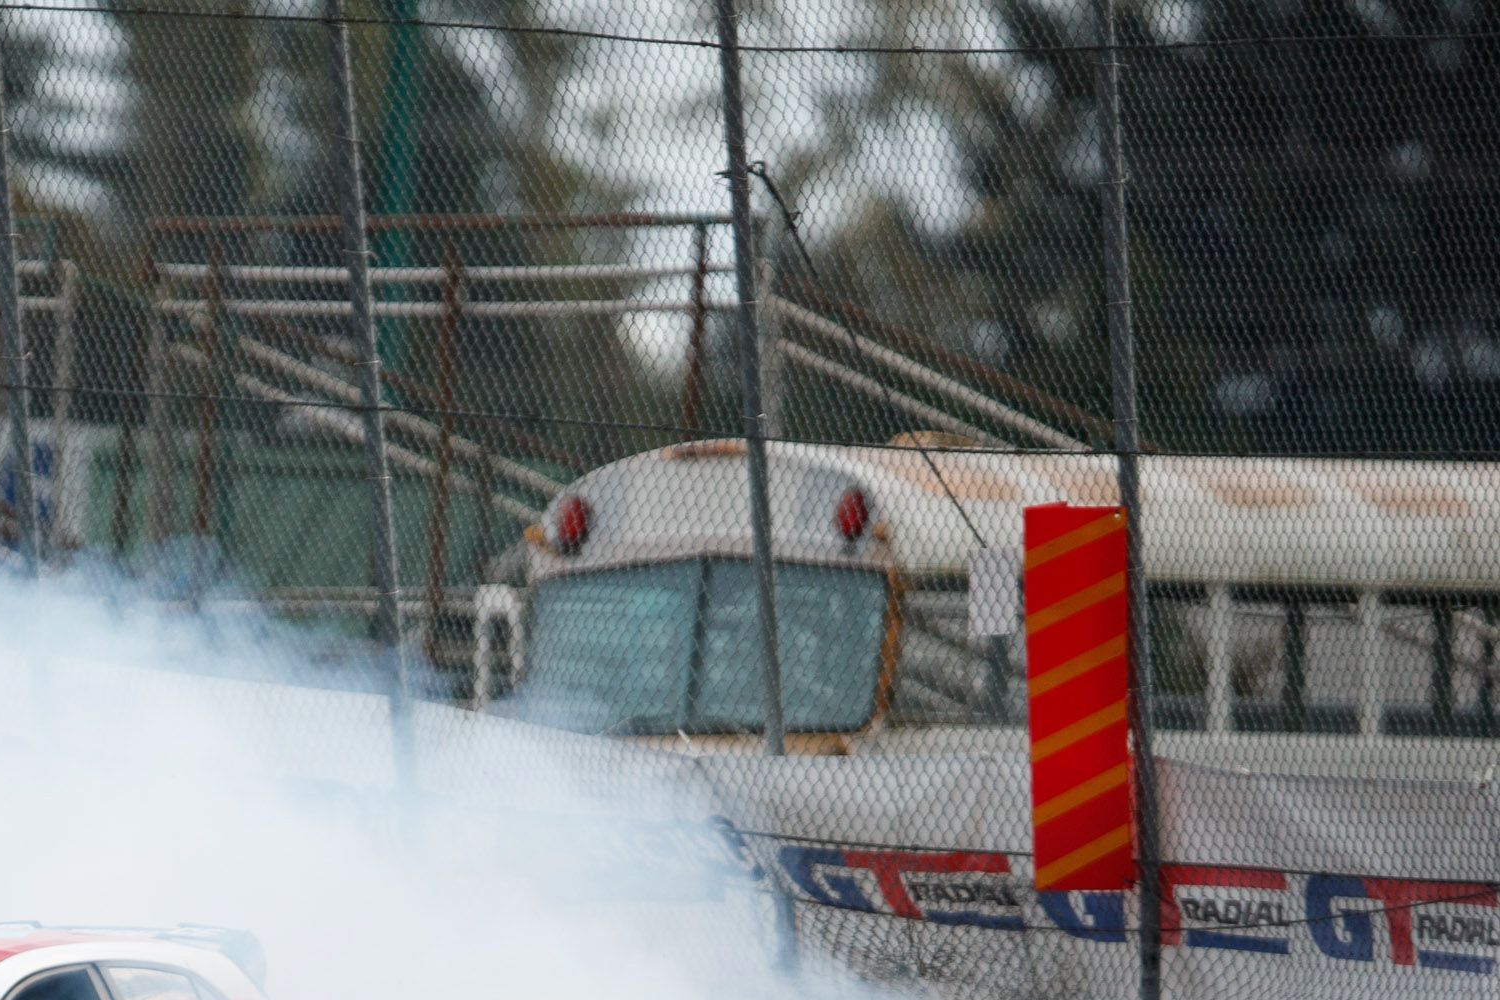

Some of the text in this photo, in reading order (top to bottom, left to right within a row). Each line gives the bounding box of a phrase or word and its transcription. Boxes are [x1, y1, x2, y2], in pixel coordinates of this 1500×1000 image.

[778, 846, 1011, 920] GT
[1181, 897, 1290, 926] RADIAL
[1304, 872, 1499, 966] GT
